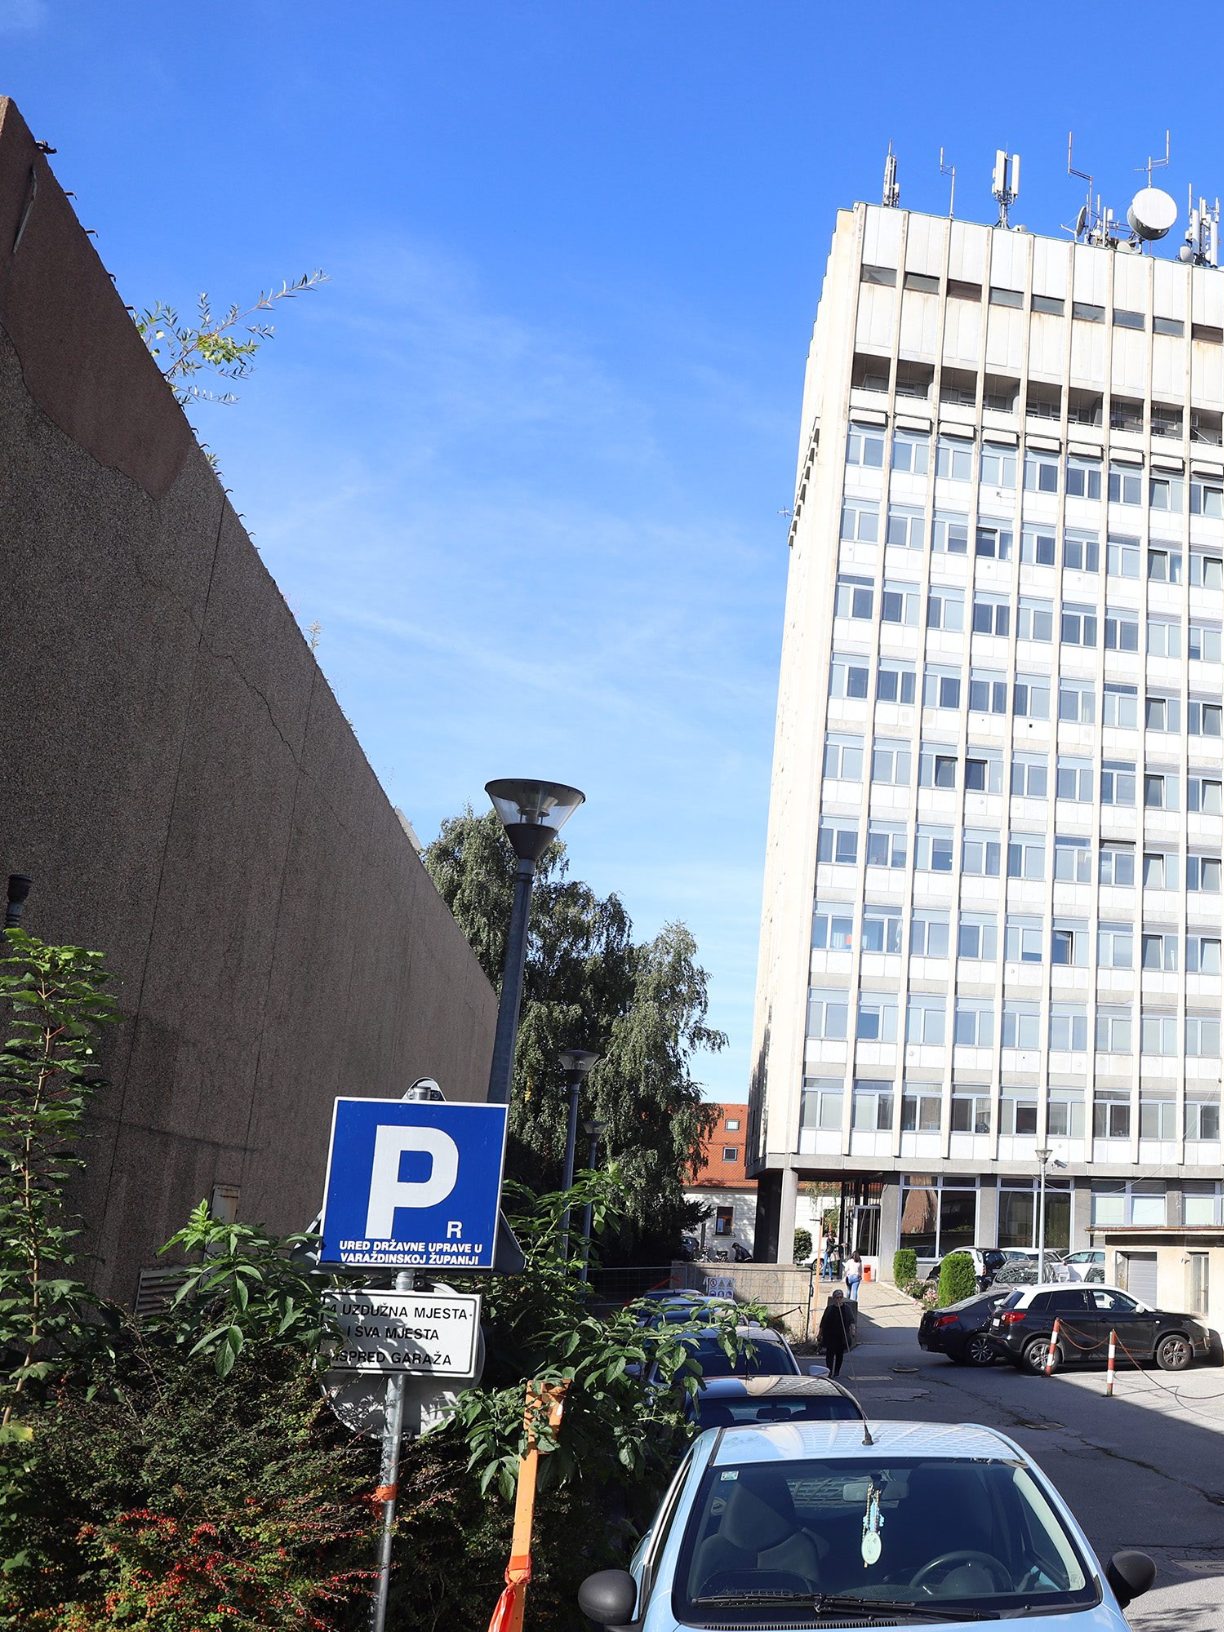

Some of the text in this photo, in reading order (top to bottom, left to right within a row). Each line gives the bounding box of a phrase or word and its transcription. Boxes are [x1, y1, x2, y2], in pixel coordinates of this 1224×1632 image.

[365, 1124, 459, 1240] P
[446, 1221, 463, 1239] R
[339, 1239, 482, 1253] URED DRŽAVNE UPRAVE U
[340, 1251, 479, 1265] VARAŽDINSKOJ ŽUPANIJI
[343, 1302, 408, 1318] UZDUŽNA
[354, 1326, 380, 1338] SVA
[385, 1328, 439, 1340] MJESTA
[391, 1351, 451, 1366] GARAŽA
